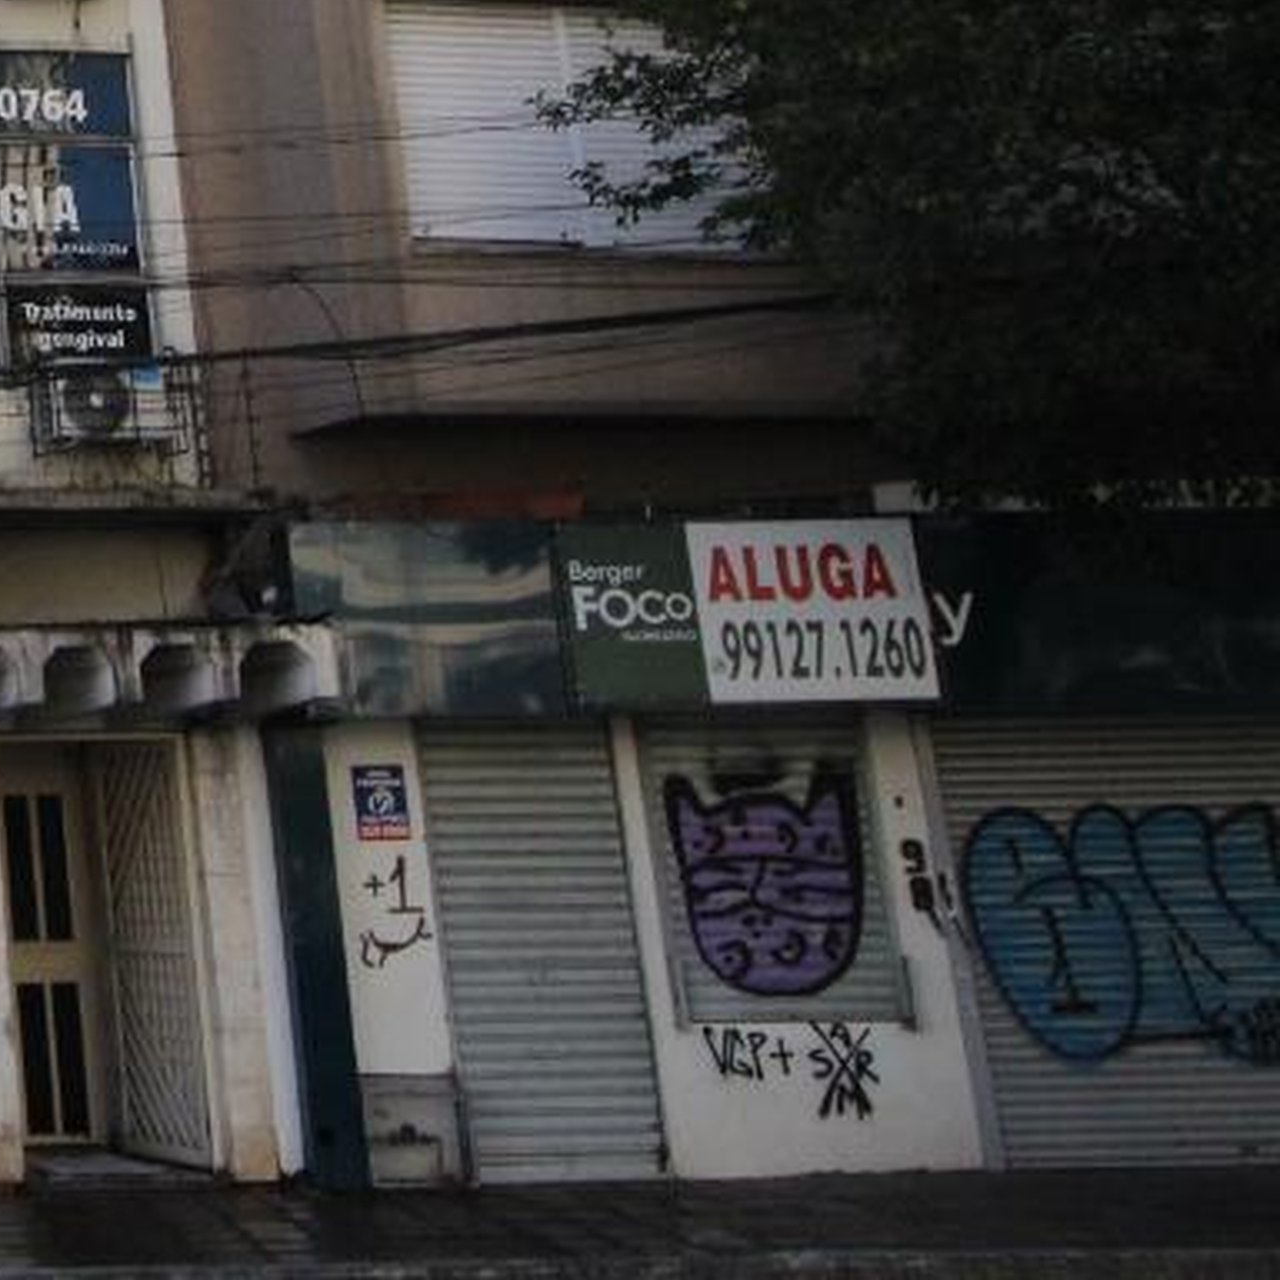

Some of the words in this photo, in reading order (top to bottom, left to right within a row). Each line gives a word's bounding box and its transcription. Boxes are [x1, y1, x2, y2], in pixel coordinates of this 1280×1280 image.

[22, 302, 139, 324] Tratamento
[707, 542, 899, 603] ALUGA
[721, 616, 927, 680] 99127.1260
